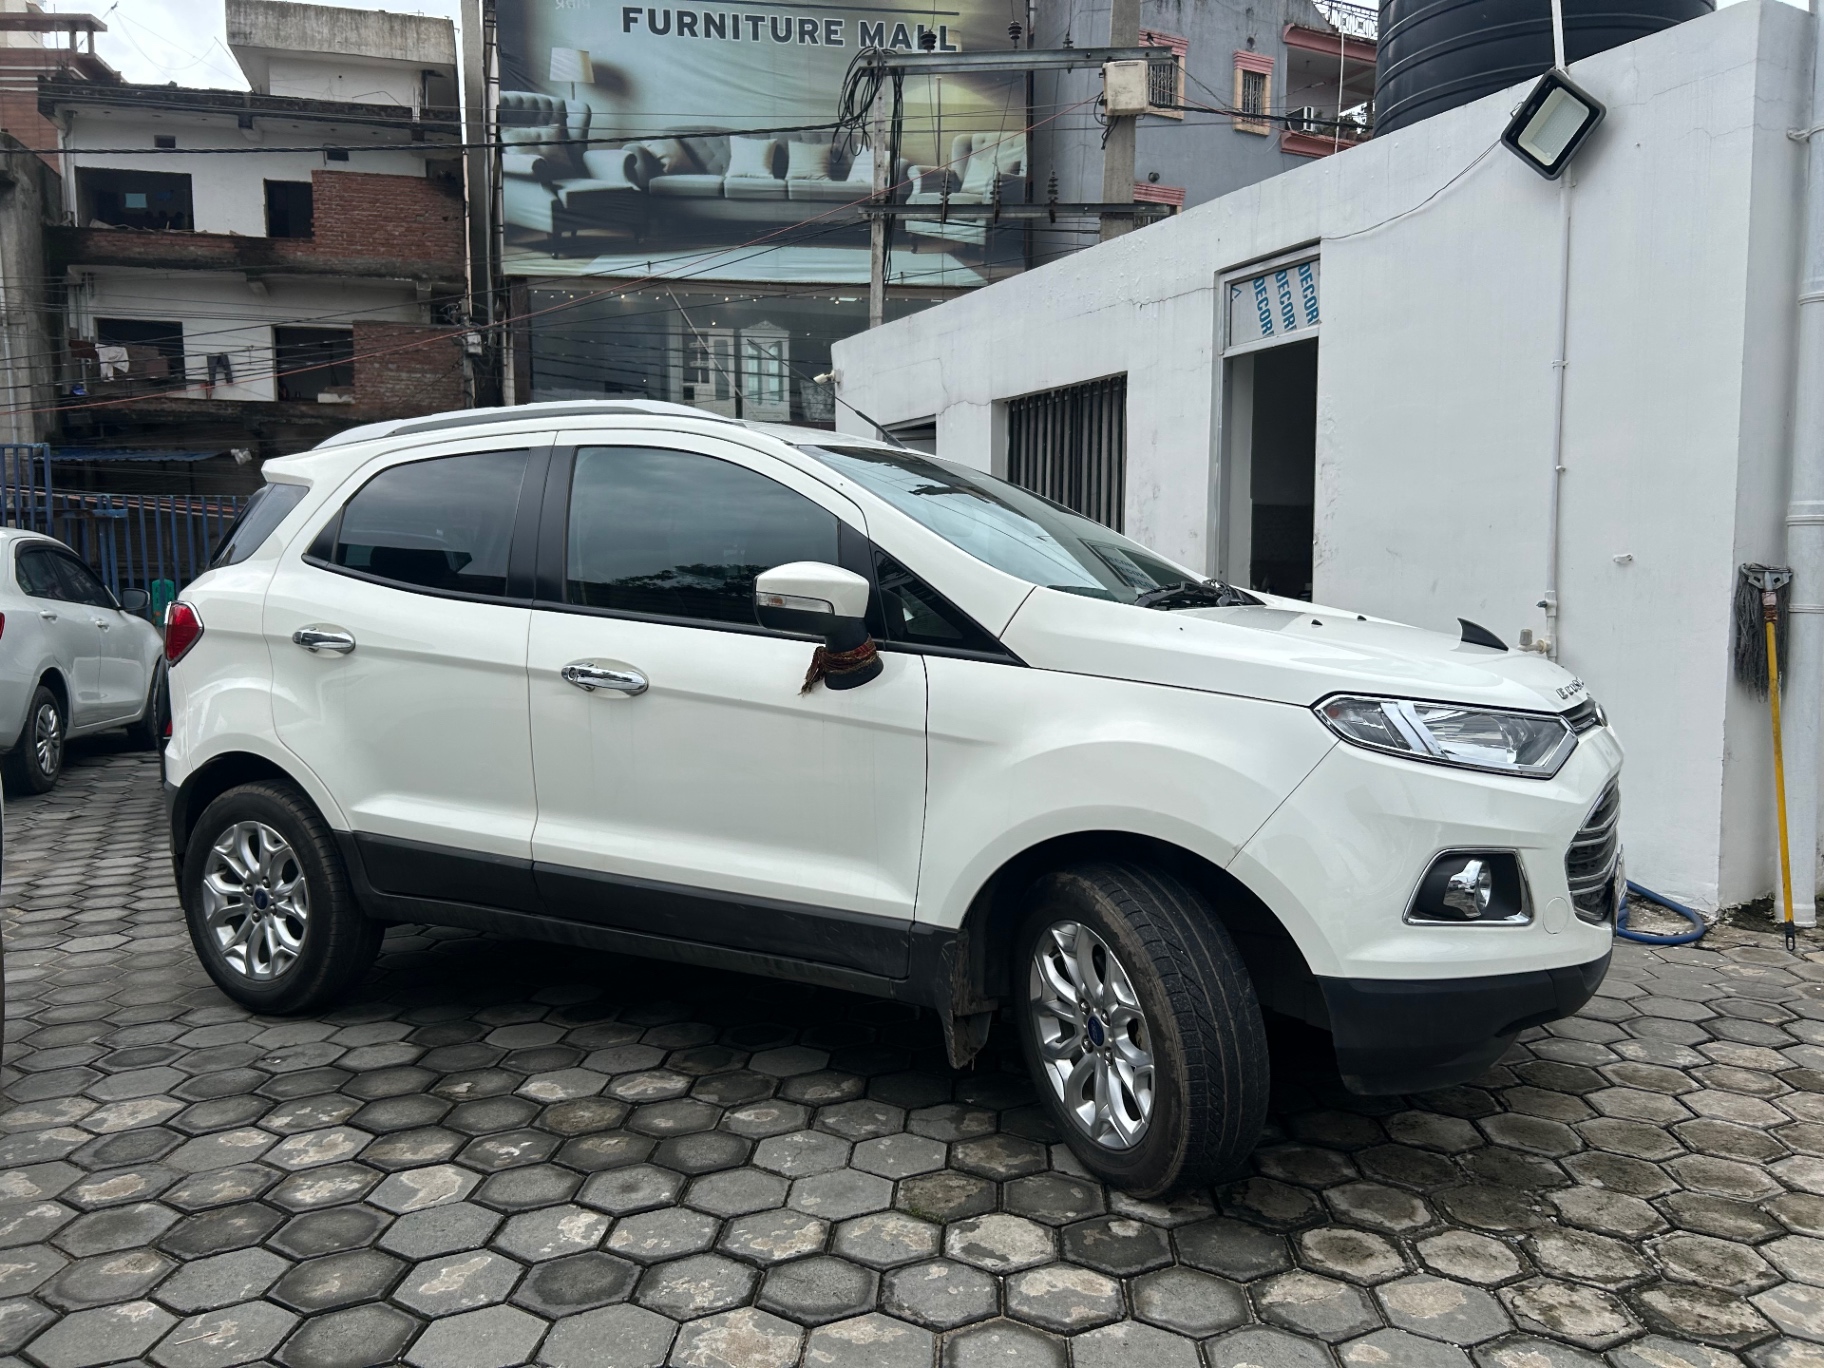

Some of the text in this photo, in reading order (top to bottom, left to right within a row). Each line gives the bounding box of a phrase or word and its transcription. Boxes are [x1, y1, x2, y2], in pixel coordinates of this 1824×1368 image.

[622, 6, 957, 52] FURNITURE MALL
[1252, 276, 1275, 337] DECOR
[1274, 269, 1298, 331] DECOR
[1298, 262, 1320, 327] DECOR
